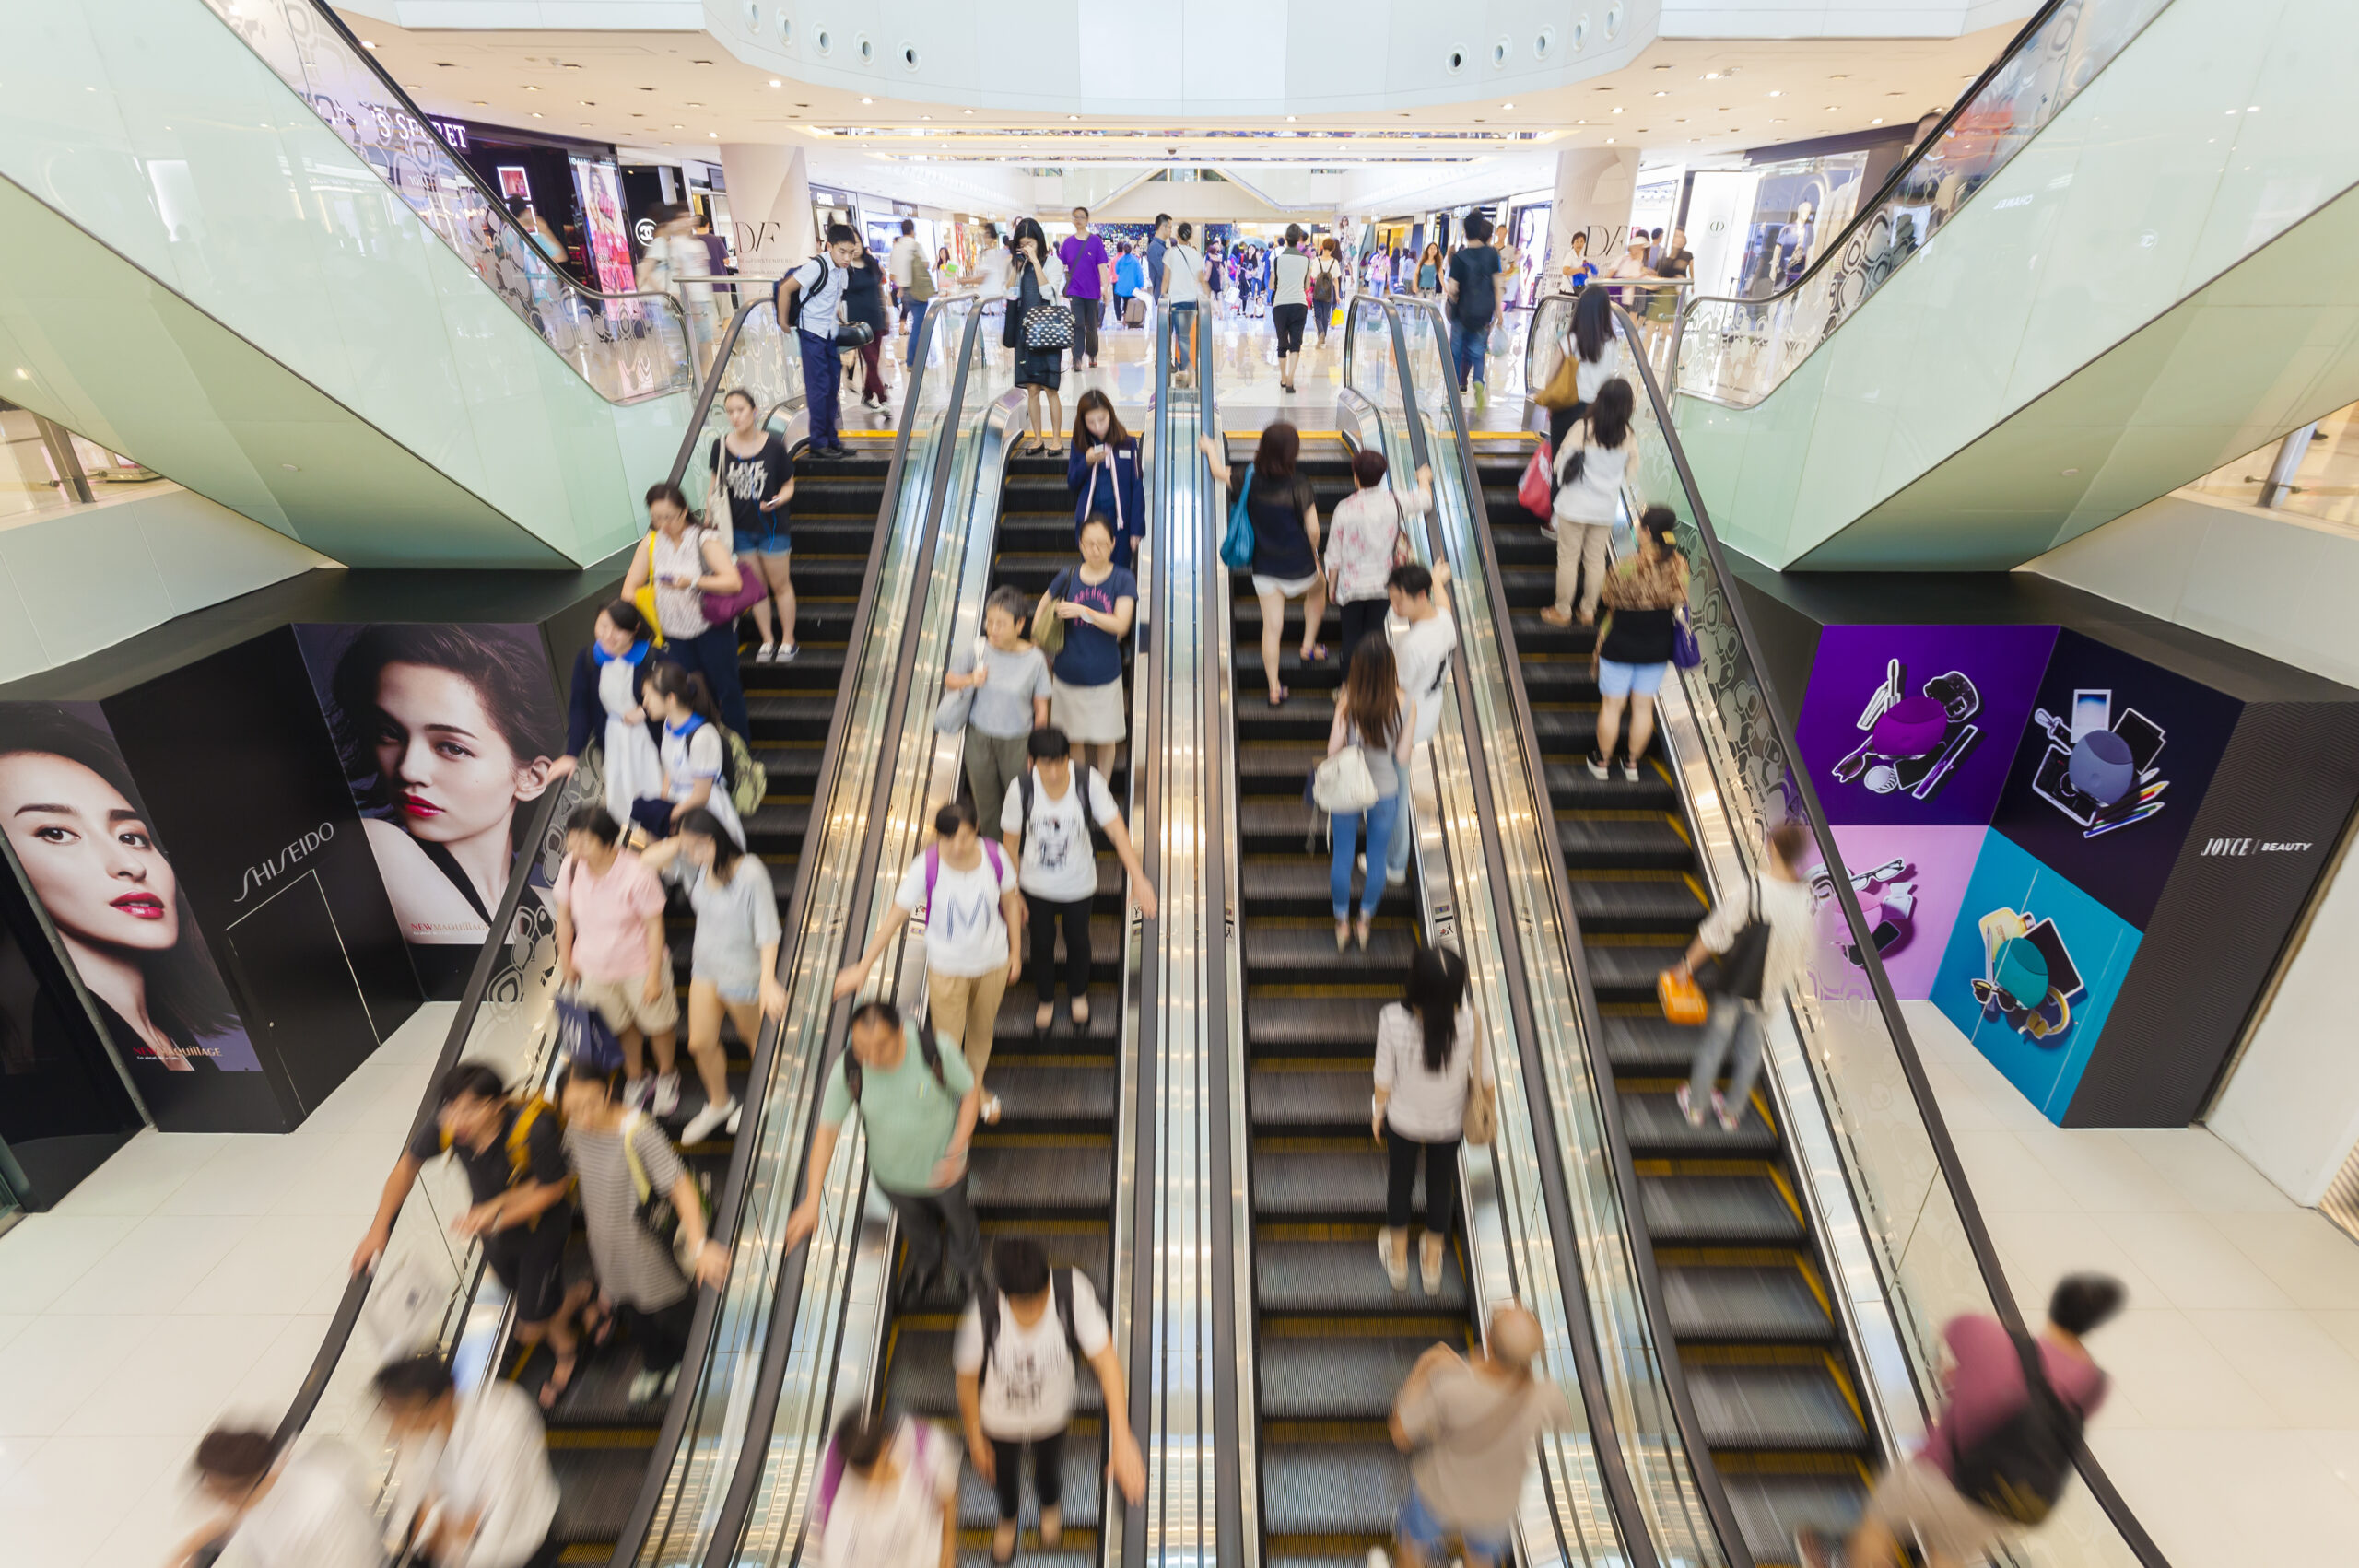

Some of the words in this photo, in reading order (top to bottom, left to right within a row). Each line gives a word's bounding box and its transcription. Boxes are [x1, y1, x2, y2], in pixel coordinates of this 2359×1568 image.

[233, 822, 334, 902] SHISEIDO
[2200, 837, 2253, 856] JOYCE
[2261, 842, 2313, 851] BEAUTY
